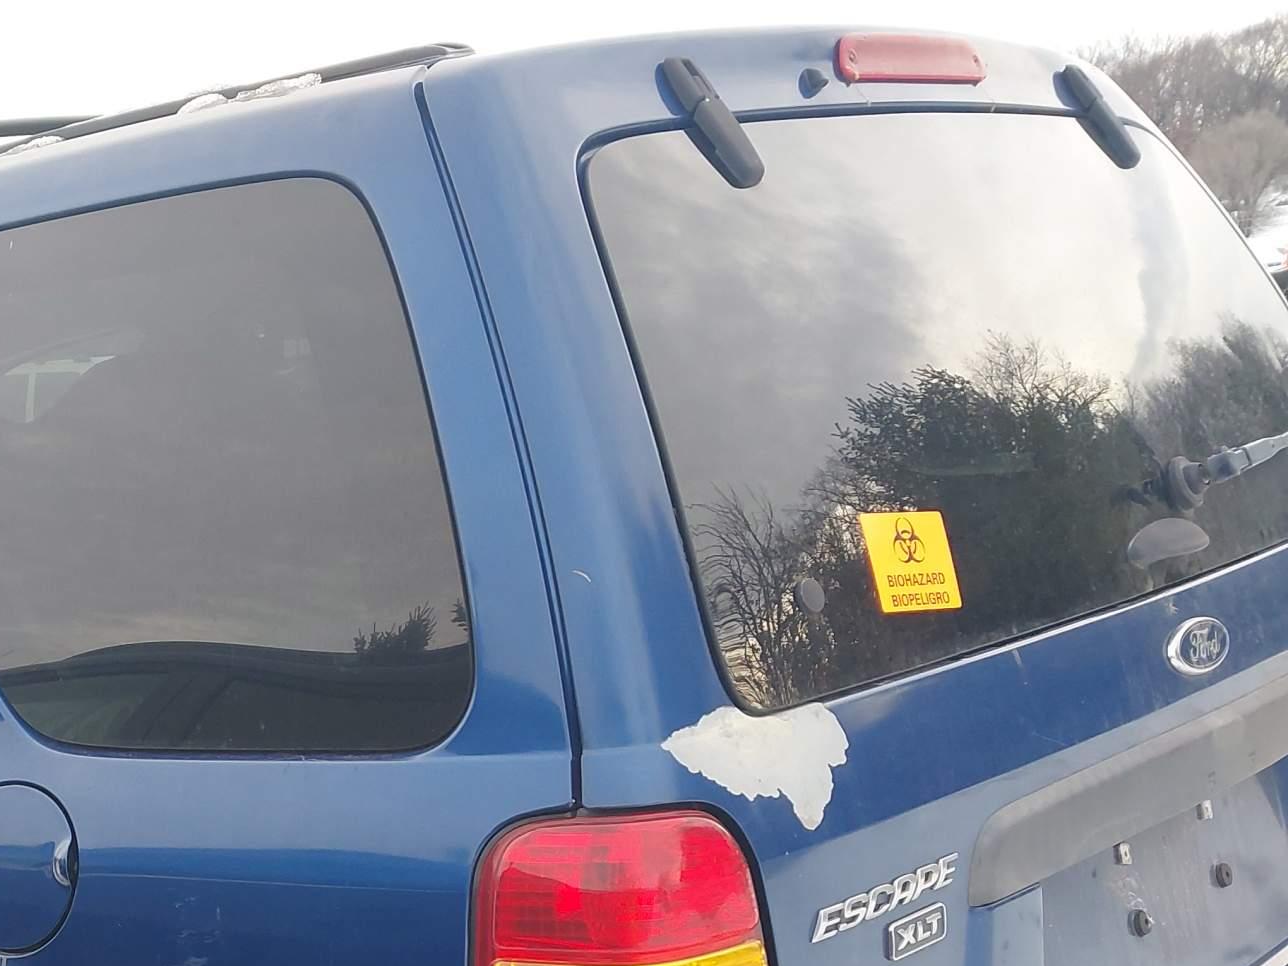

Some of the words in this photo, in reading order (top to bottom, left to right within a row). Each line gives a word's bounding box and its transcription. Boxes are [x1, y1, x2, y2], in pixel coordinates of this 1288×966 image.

[886, 571, 946, 588] BIOHAZARD
[891, 591, 951, 608] BIOPELIGRO
[1189, 627, 1221, 662] Ford
[811, 852, 959, 943] ESCAPE
[896, 912, 942, 951] XLT
